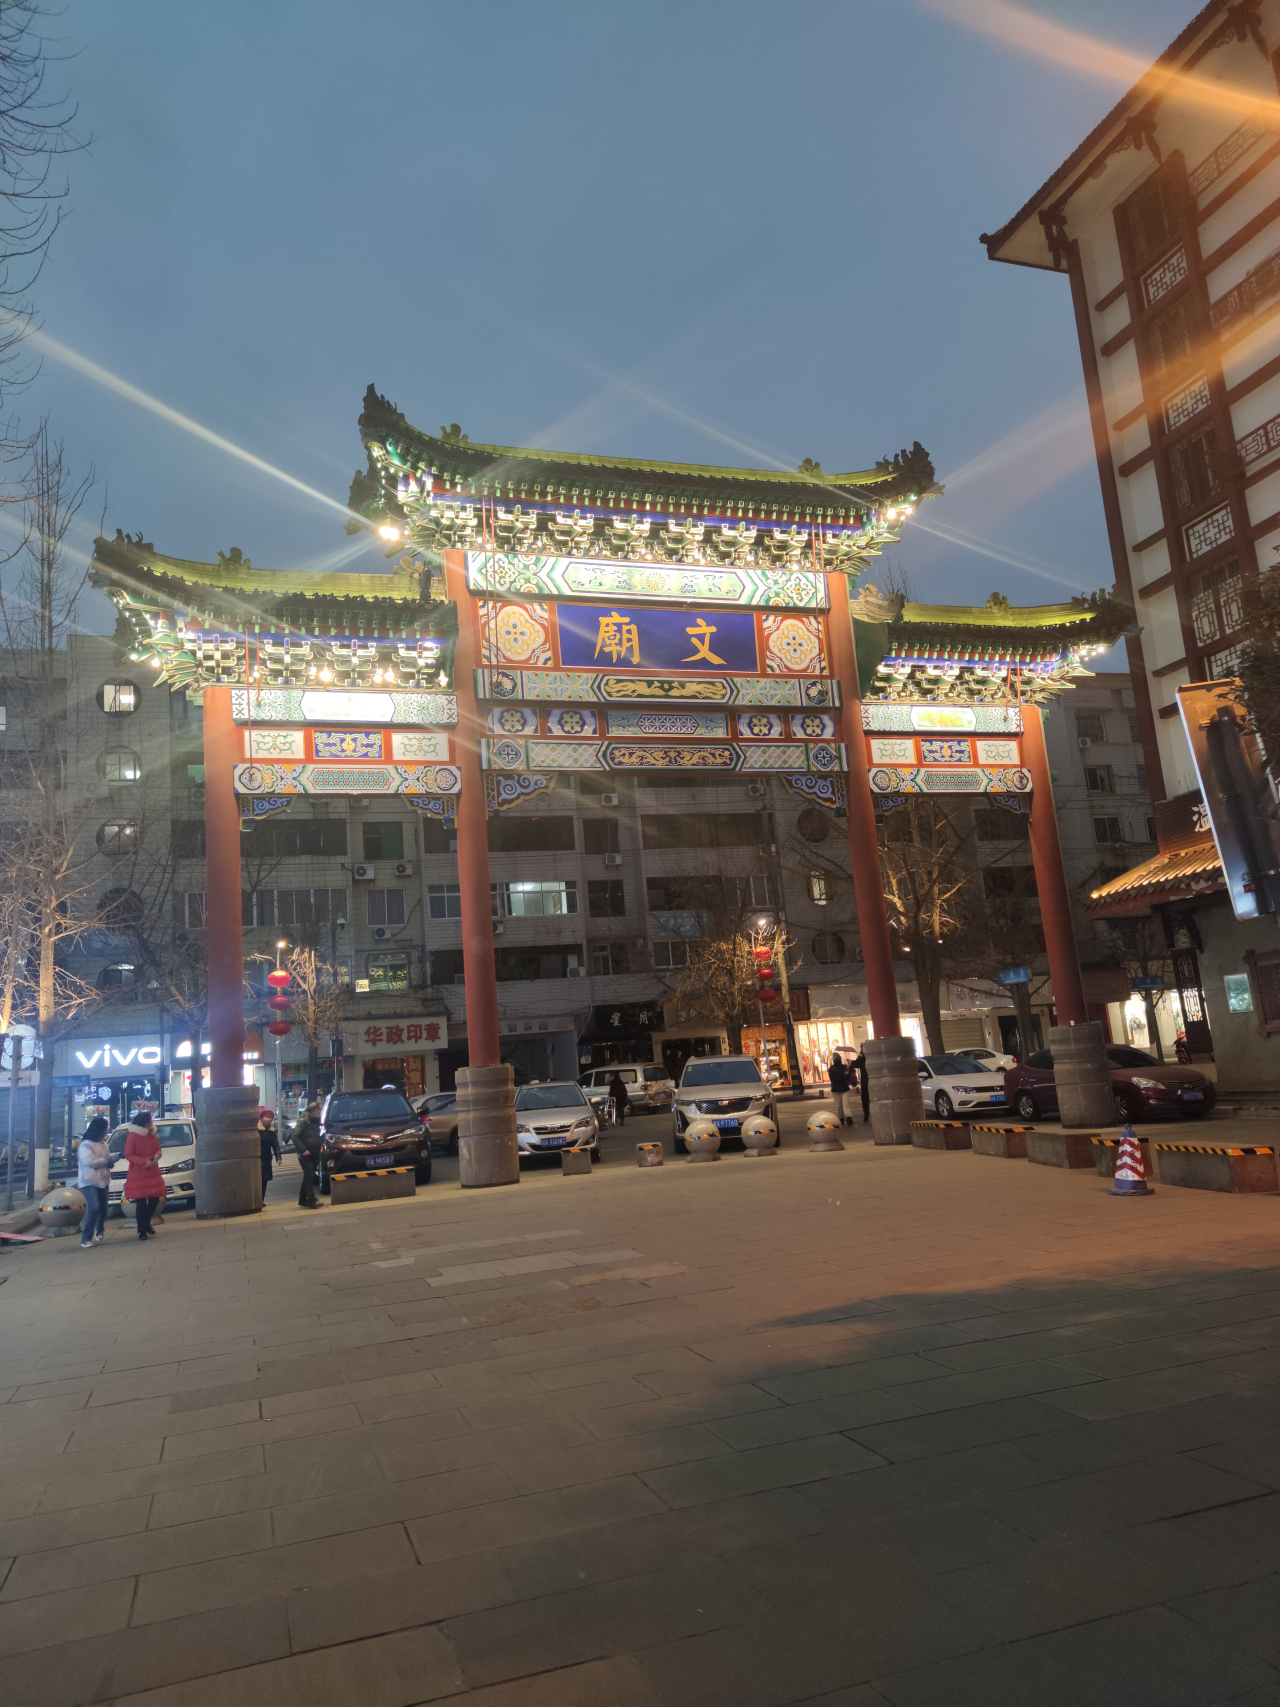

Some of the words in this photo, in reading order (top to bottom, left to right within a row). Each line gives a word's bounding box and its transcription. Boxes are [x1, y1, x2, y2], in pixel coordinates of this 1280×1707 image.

[364, 1022, 441, 1047] 华政印章
[75, 1044, 161, 1069] vivo
